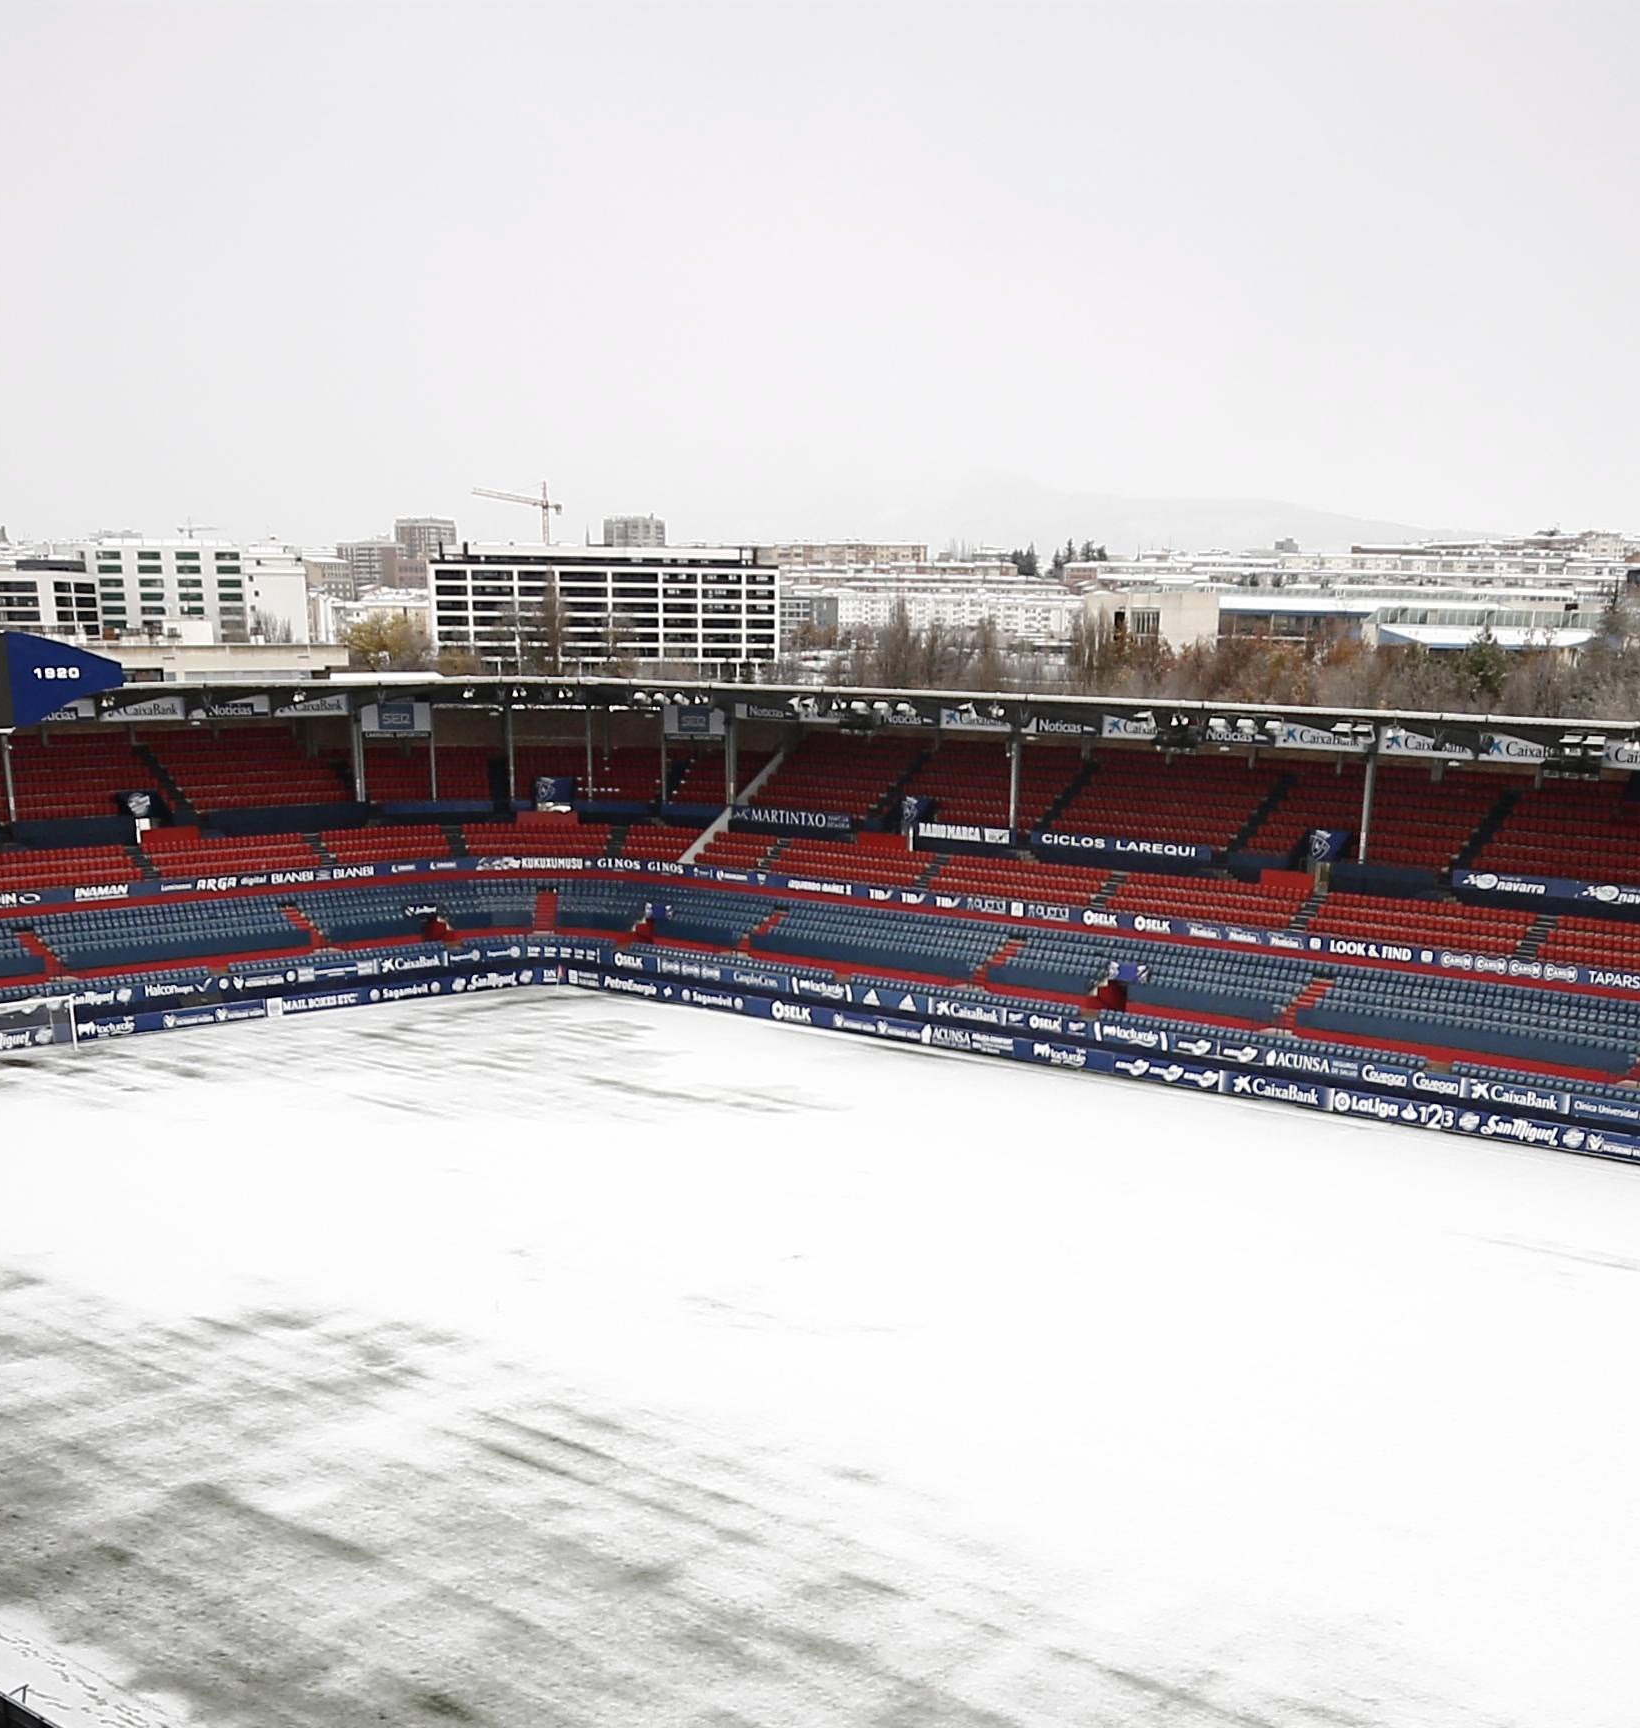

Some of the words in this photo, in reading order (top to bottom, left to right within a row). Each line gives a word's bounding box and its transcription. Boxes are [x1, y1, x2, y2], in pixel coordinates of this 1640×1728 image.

[33, 666, 80, 680] 1920
[1038, 718, 1082, 735] Noticias
[751, 808, 826, 828] MARTINTXO
[1041, 833, 1106, 850] CICLOS
[1116, 839, 1197, 858] LAREQUI
[333, 865, 374, 879] BIANBI
[522, 857, 583, 870] KUKUXUMUSU
[597, 858, 641, 871] GINOS
[647, 860, 684, 875] GINOS
[196, 876, 237, 891] ARGA
[272, 871, 314, 885] BIANBI
[75, 884, 128, 899] INAMAN
[1496, 878, 1546, 896] navarra
[1093, 912, 1118, 927] SELK
[1146, 919, 1171, 933] SELK
[1329, 939, 1367, 957] LOOK
[1368, 944, 1380, 958] &
[1381, 944, 1413, 962] FIND
[395, 956, 442, 971] CaixaBank
[282, 997, 308, 1012] MAIL
[784, 1003, 812, 1022] SELK
[949, 1002, 999, 1024] CaixaBank
[932, 1027, 972, 1044] ACUNSA
[1276, 1051, 1330, 1073] ACUNSA
[1252, 1077, 1318, 1105] CaixaBank
[1491, 1083, 1558, 1112] CaixaBank
[1351, 1095, 1399, 1119] LaLiga
[1419, 1103, 1455, 1131] 123
[1598, 1103, 1638, 1121] Universidad
